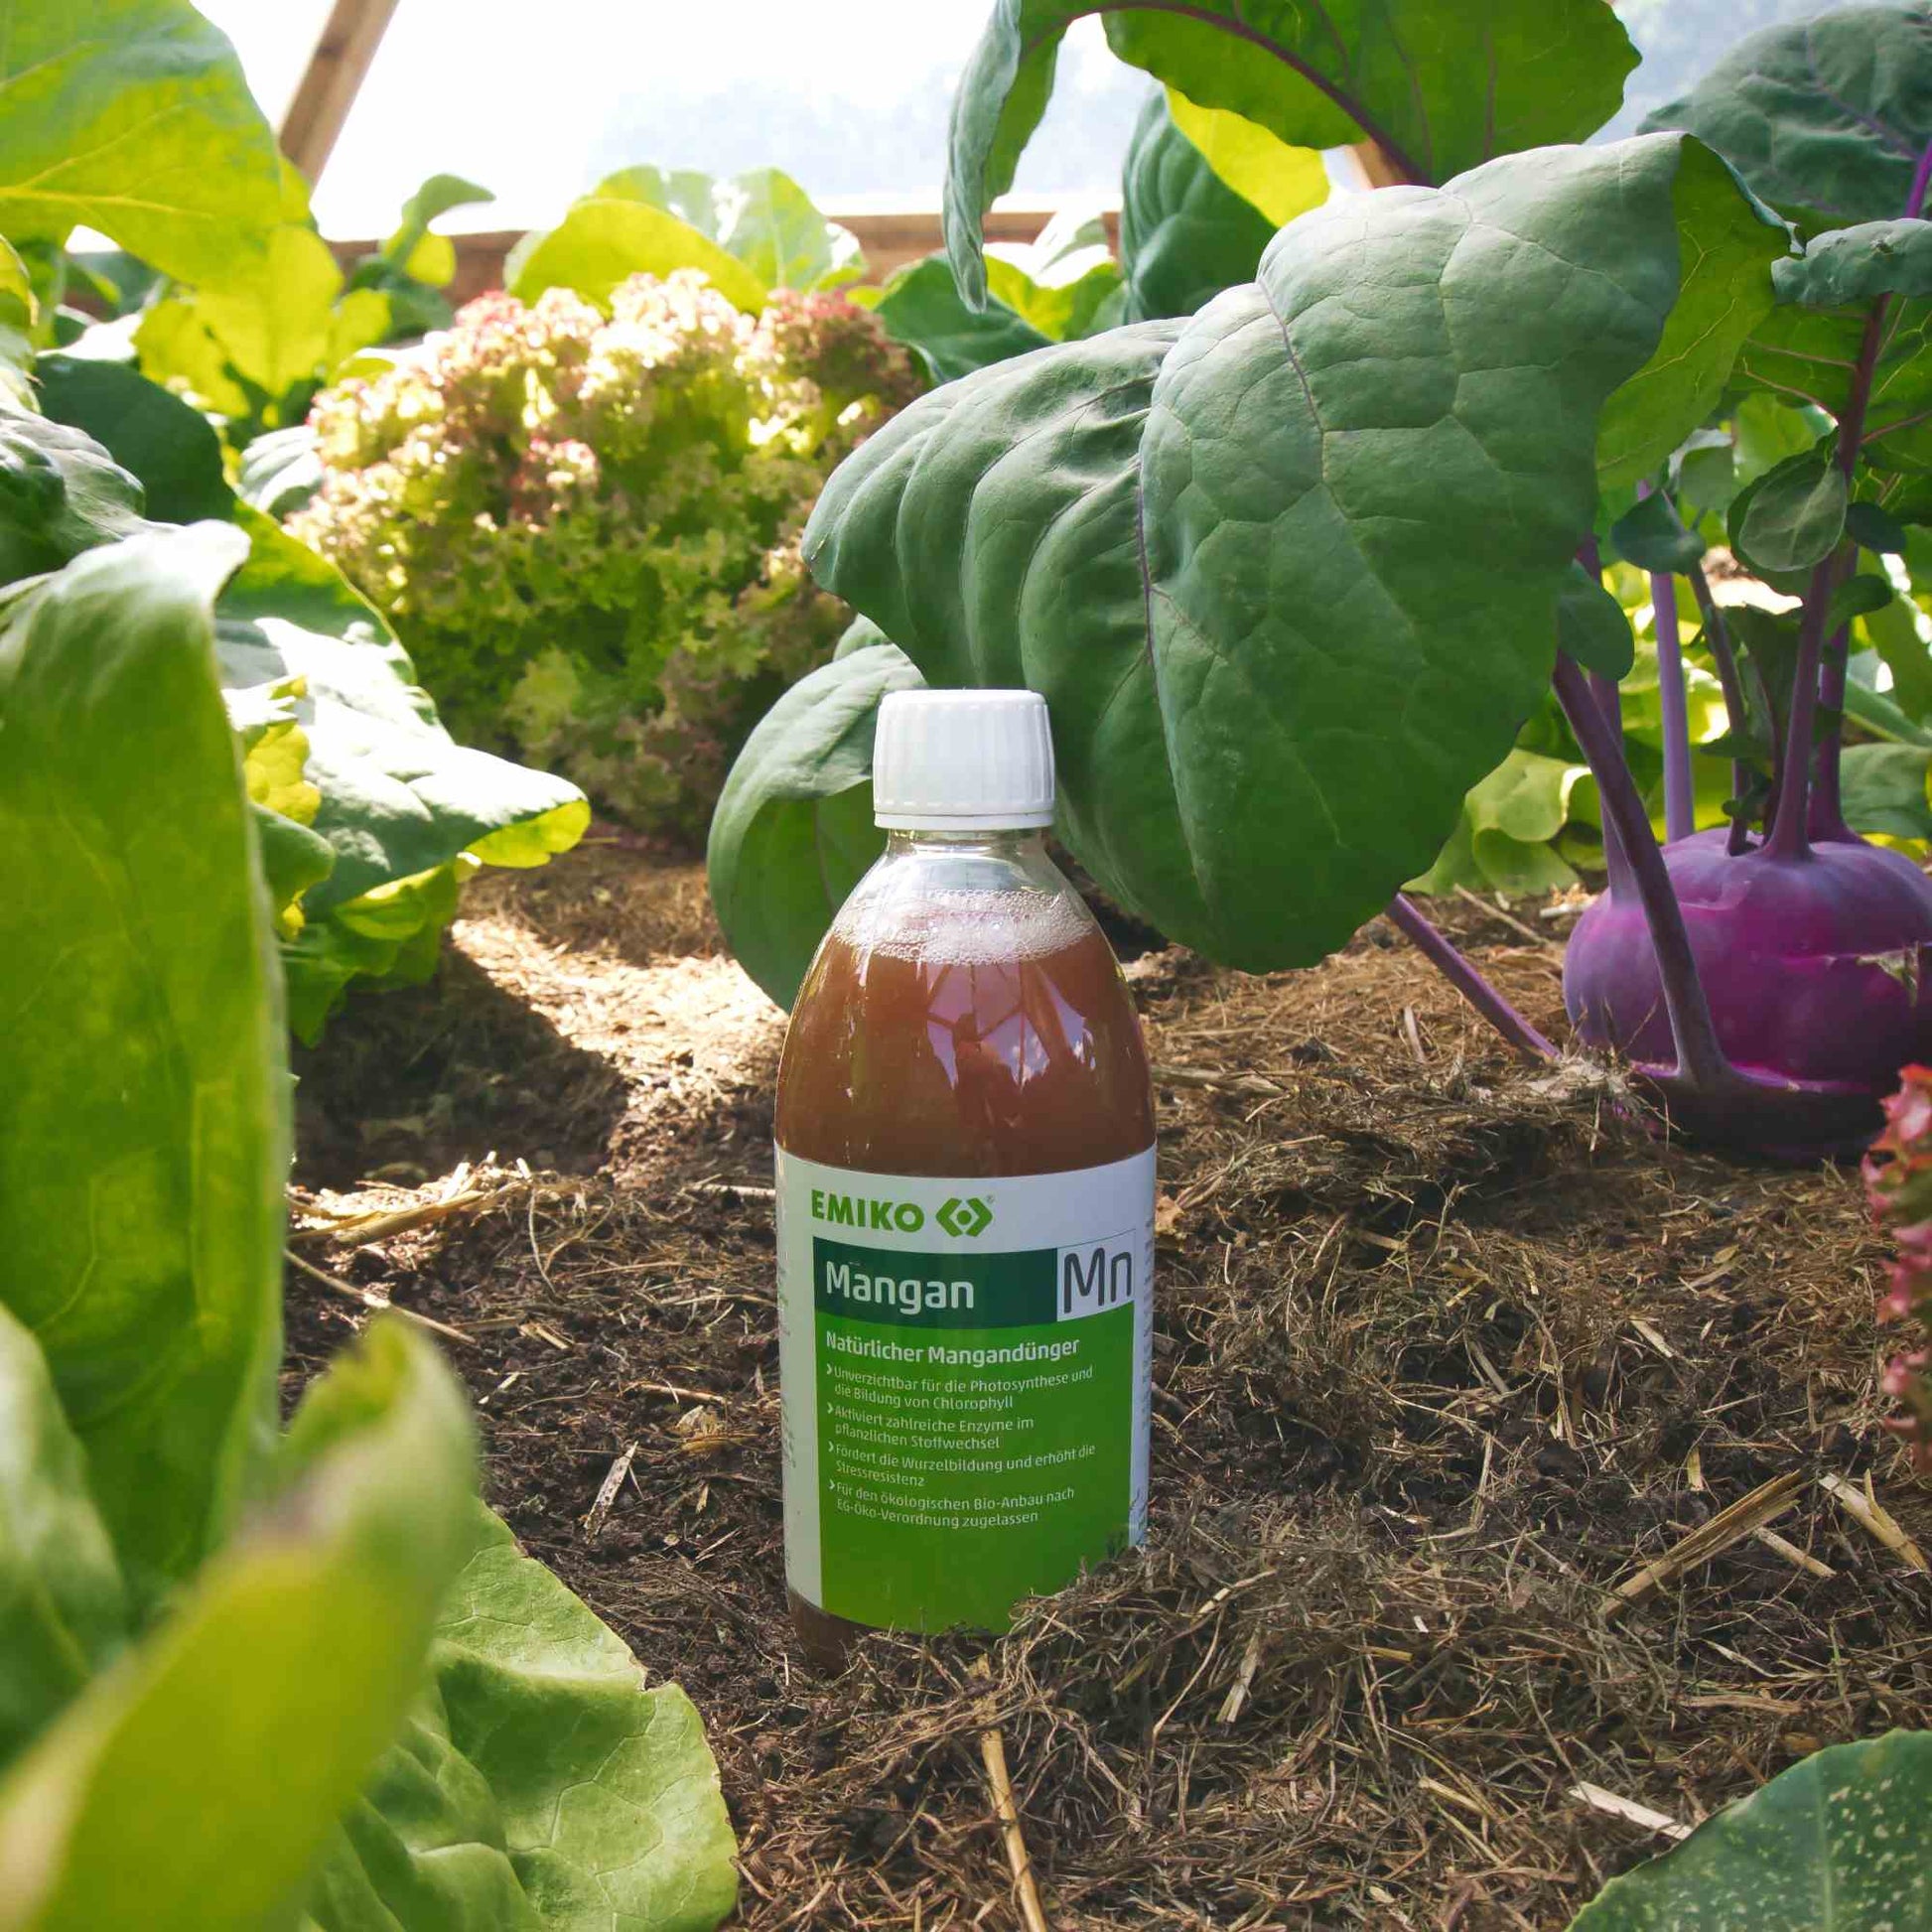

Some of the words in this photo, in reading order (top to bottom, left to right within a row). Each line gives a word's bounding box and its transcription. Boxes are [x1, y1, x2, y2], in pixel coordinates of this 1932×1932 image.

[811, 1189, 924, 1232] EMIKO
[826, 1261, 974, 1314] Mangan
[1063, 1247, 1132, 1313] Mn
[826, 1330, 923, 1362] Natürlicher
[928, 1339, 1080, 1368] Mangandünger
[834, 1365, 918, 1391] Unverzichtbar
[921, 1378, 940, 1392] für
[944, 1379, 966, 1393] die
[970, 1373, 1068, 1393] Photosynthese
[1071, 1364, 1093, 1382] und
[835, 1383, 851, 1397] die
[854, 1387, 901, 1408] Bildung
[904, 1398, 929, 1408] von
[933, 1396, 1013, 1411] Chlorophyll
[835, 1405, 883, 1426] Aktiviert
[886, 1417, 955, 1432] zahlreiche
[959, 1420, 1014, 1434] Enzyme
[1017, 1417, 1034, 1430] im
[835, 1423, 907, 1447] pflanzlichen
[911, 1436, 1000, 1449] Stoffwechsel
[836, 1444, 877, 1464] Fördert
[879, 1453, 898, 1467] die
[901, 1456, 1003, 1473] Wurzelbildung
[1007, 1454, 1033, 1469] und
[1078, 1445, 1096, 1458] die
[836, 1459, 925, 1487] Stressresistenz
[837, 1481, 853, 1496] Für
[856, 1488, 878, 1502] den
[880, 1491, 970, 1511] ökologischen
[974, 1494, 1043, 1510] Bio-Anbau
[1046, 1486, 1074, 1502] nach
[837, 1498, 959, 1529] EG-Öko-Verordnung
[962, 1512, 1038, 1529] zugelassen
